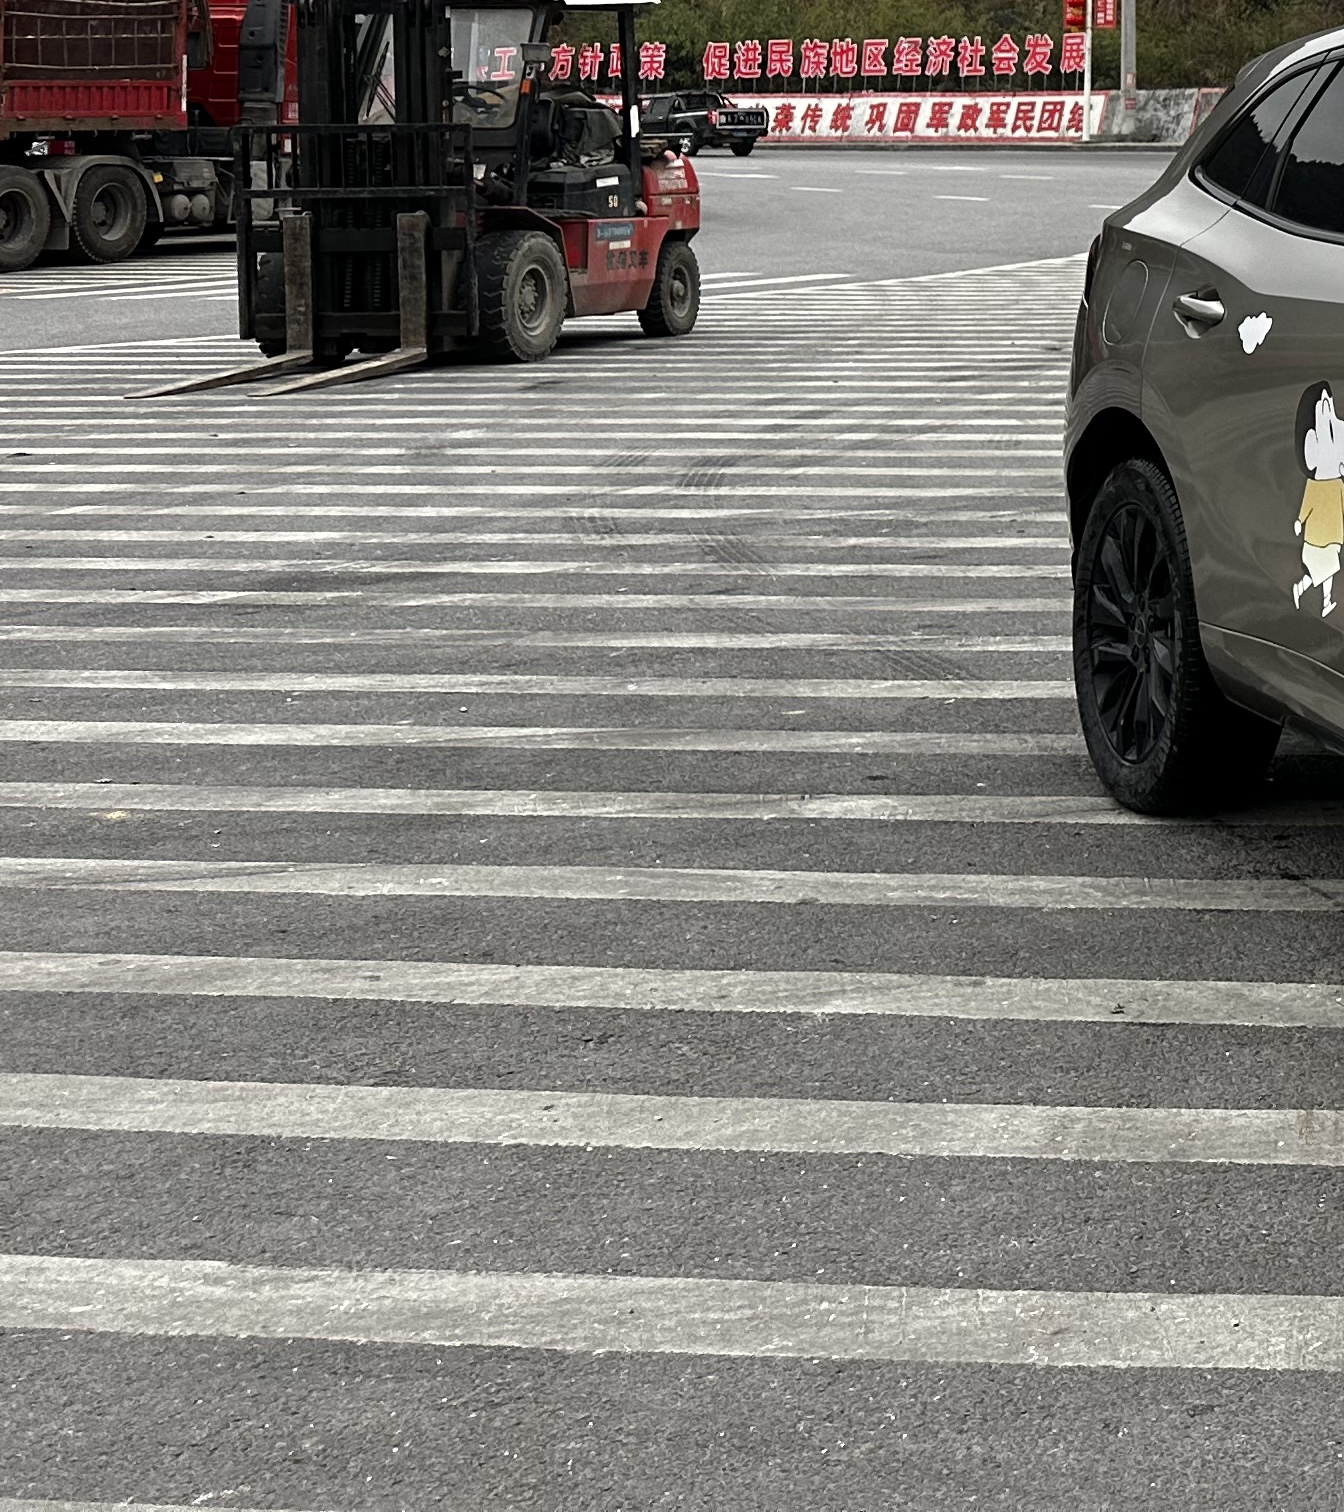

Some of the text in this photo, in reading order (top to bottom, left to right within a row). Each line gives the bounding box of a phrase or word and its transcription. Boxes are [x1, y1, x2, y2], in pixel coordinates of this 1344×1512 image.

[703, 32, 1087, 80] 促进民族地区经济社会发展
[752, 102, 854, 135] 荣传统
